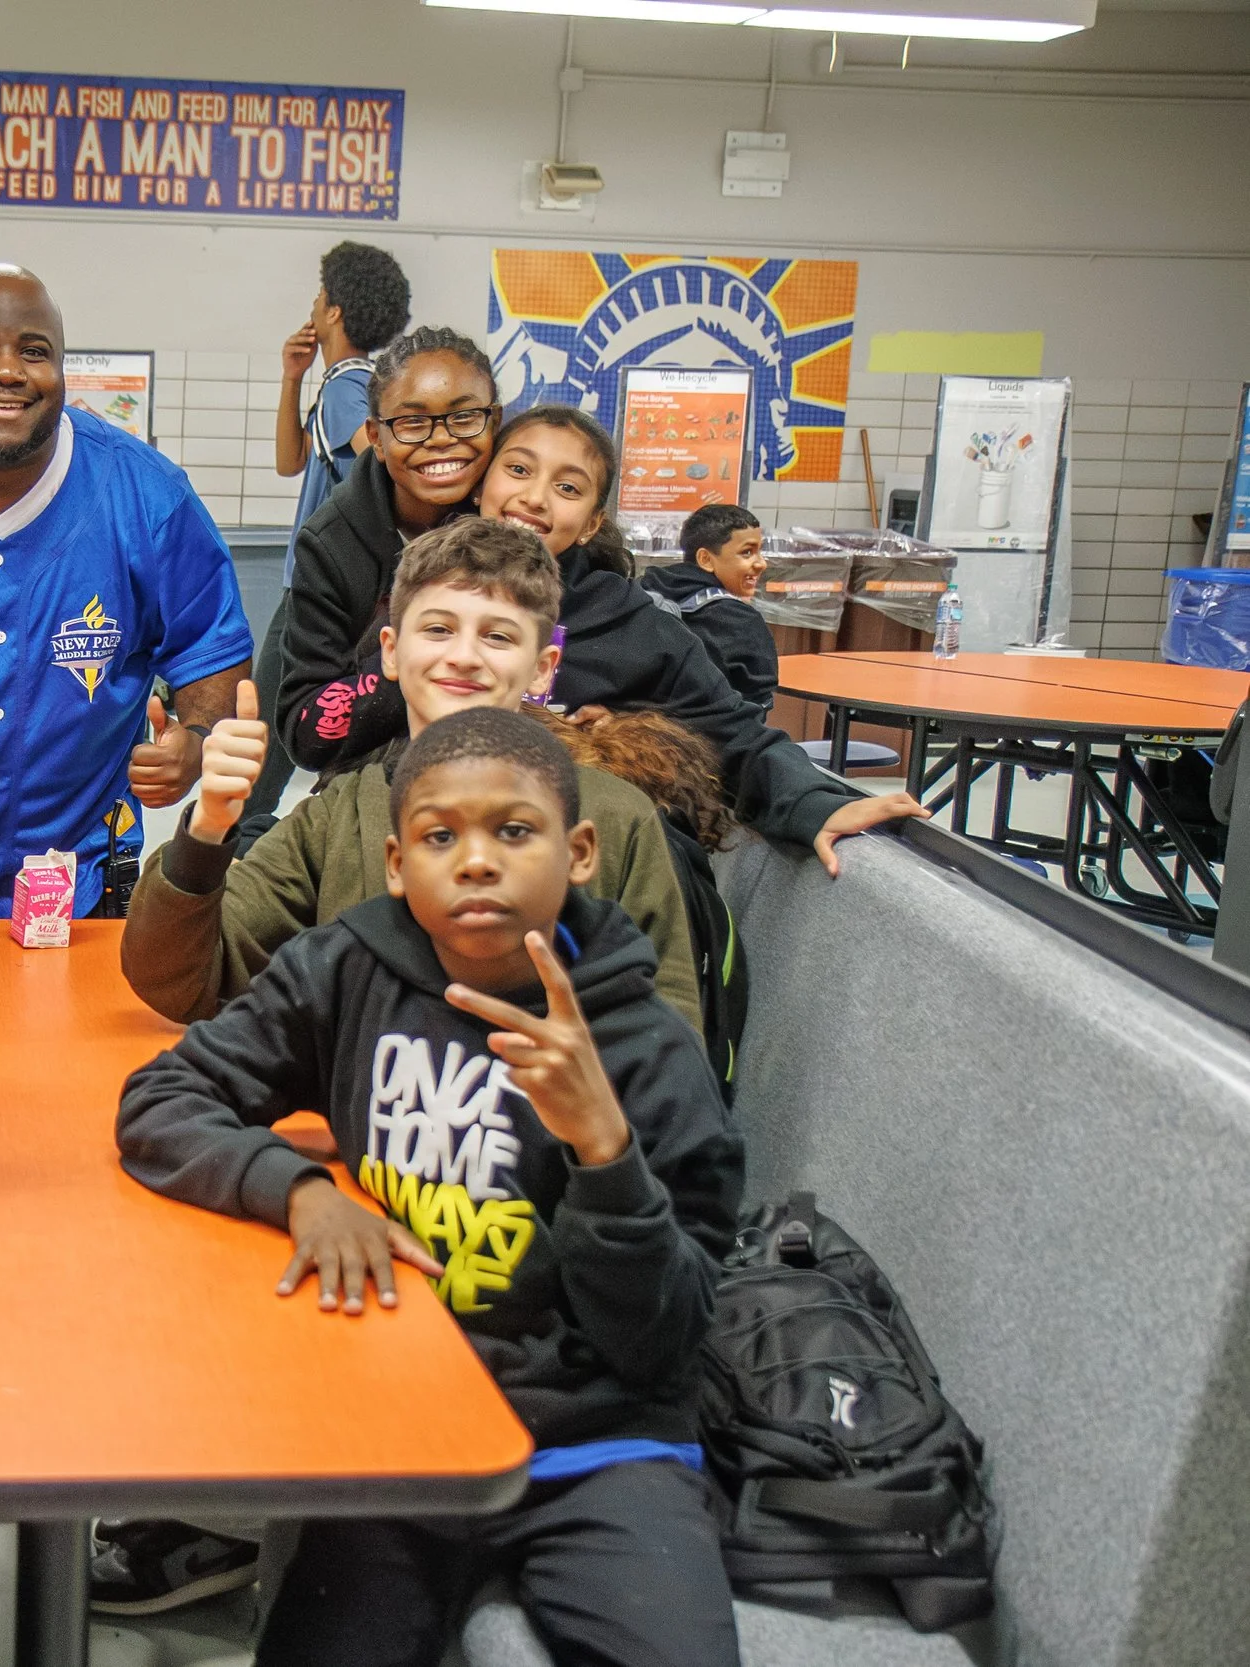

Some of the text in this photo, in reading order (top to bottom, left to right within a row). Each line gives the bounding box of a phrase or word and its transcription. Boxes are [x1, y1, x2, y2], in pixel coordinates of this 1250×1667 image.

[1, 84, 48, 115] MAN
[55, 86, 72, 117] A
[77, 87, 124, 119] FISH
[130, 89, 171, 121] AND
[177, 91, 227, 123] FEED
[233, 93, 271, 126] HIM
[278, 96, 317, 127] FOR
[323, 98, 340, 129] A
[346, 100, 392, 131] DAY.
[74, 118, 105, 174] A
[121, 120, 212, 178] MAN
[230, 124, 286, 180] TO
[302, 127, 389, 184] FISH
[73, 174, 122, 202] HIM
[139, 176, 188, 206] FOR
[205, 179, 222, 206] A
[86, 355, 111, 368] Only
[988, 380, 1024, 393] Liquids
[51, 635, 121, 652] NEW PREP
[55, 650, 91, 660] MIDDLE
[36, 924, 59, 934] Milk
